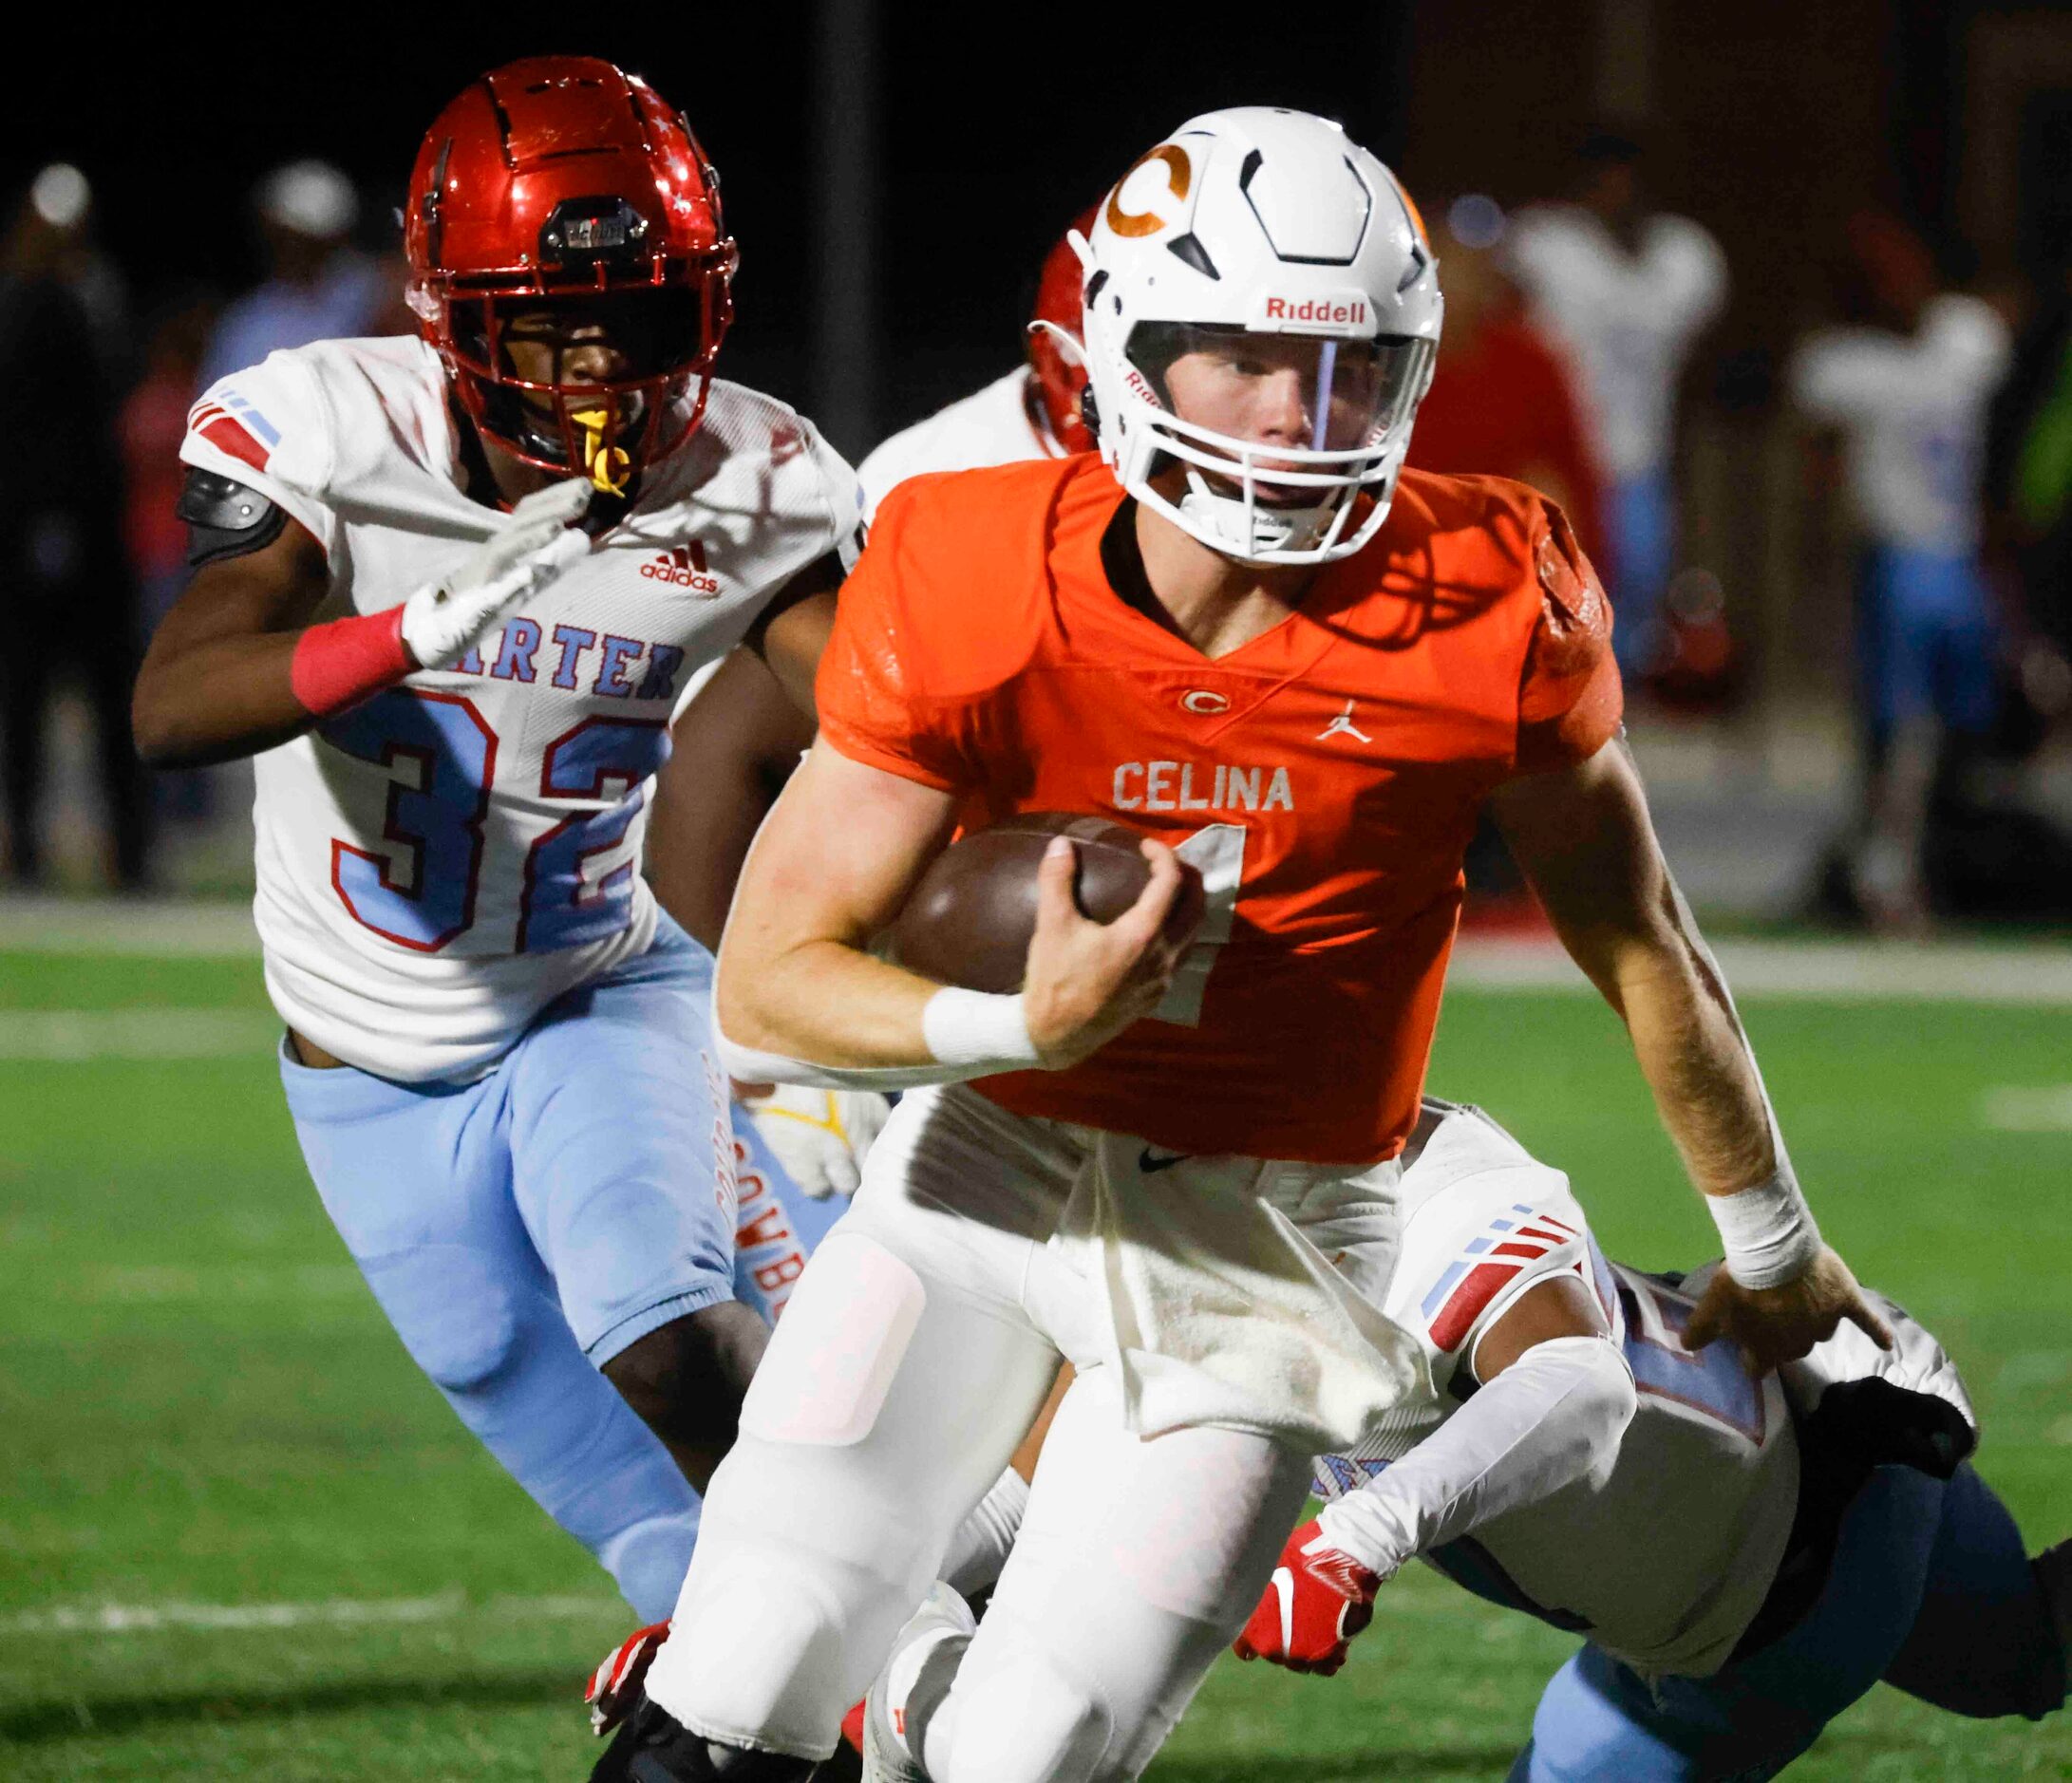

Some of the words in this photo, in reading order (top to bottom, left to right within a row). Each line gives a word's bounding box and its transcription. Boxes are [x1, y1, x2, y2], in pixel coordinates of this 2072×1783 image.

[1267, 297, 1365, 324] Riddell
[640, 563, 718, 592] adidas
[1113, 761, 1294, 811] CELINA
[319, 687, 673, 954] 32
